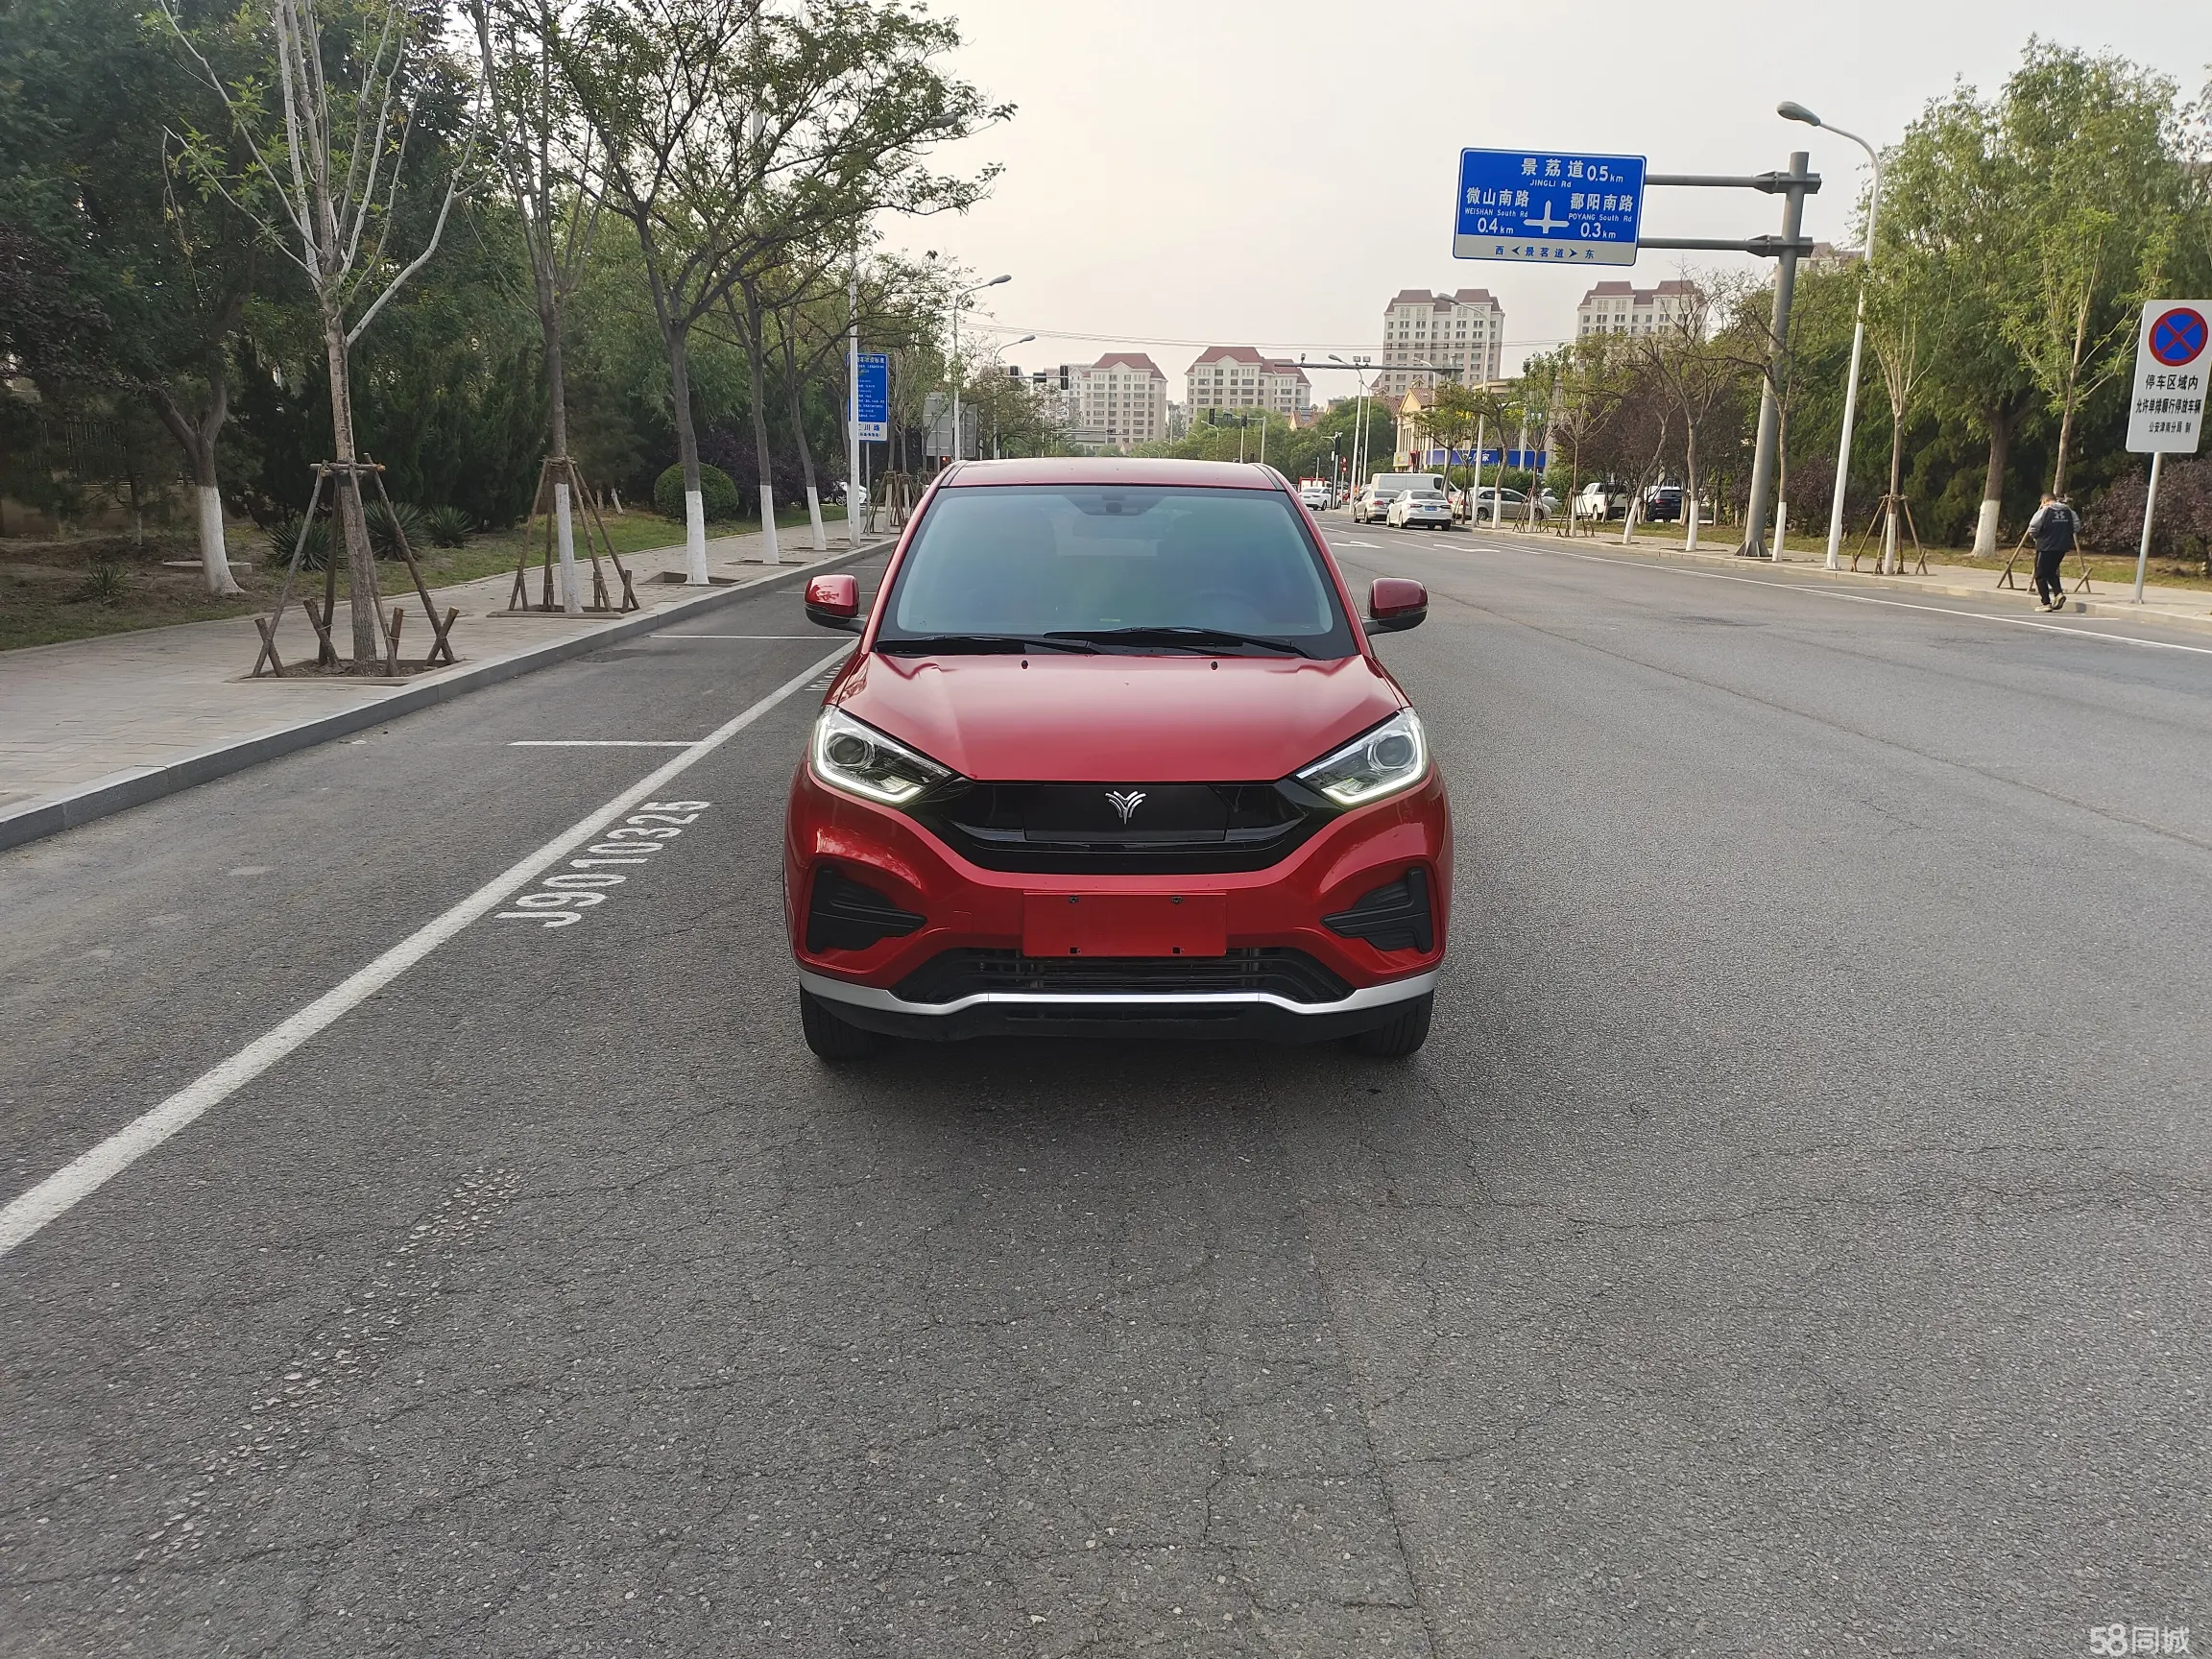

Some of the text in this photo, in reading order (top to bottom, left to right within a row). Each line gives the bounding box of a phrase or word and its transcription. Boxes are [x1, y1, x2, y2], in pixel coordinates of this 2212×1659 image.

[1521, 157, 1584, 179] 景荔道
[1466, 186, 1529, 207] 微山南路
[1570, 192, 1633, 212] 鄱阳南路
[1465, 207, 1493, 216] WEISHAN
[1495, 245, 1595, 259] 西 景茗道 东
[2146, 374, 2199, 391] 停车区域内
[2135, 397, 2202, 414] 允许单排顺行停放车辆
[493, 801, 710, 927] J9010325
